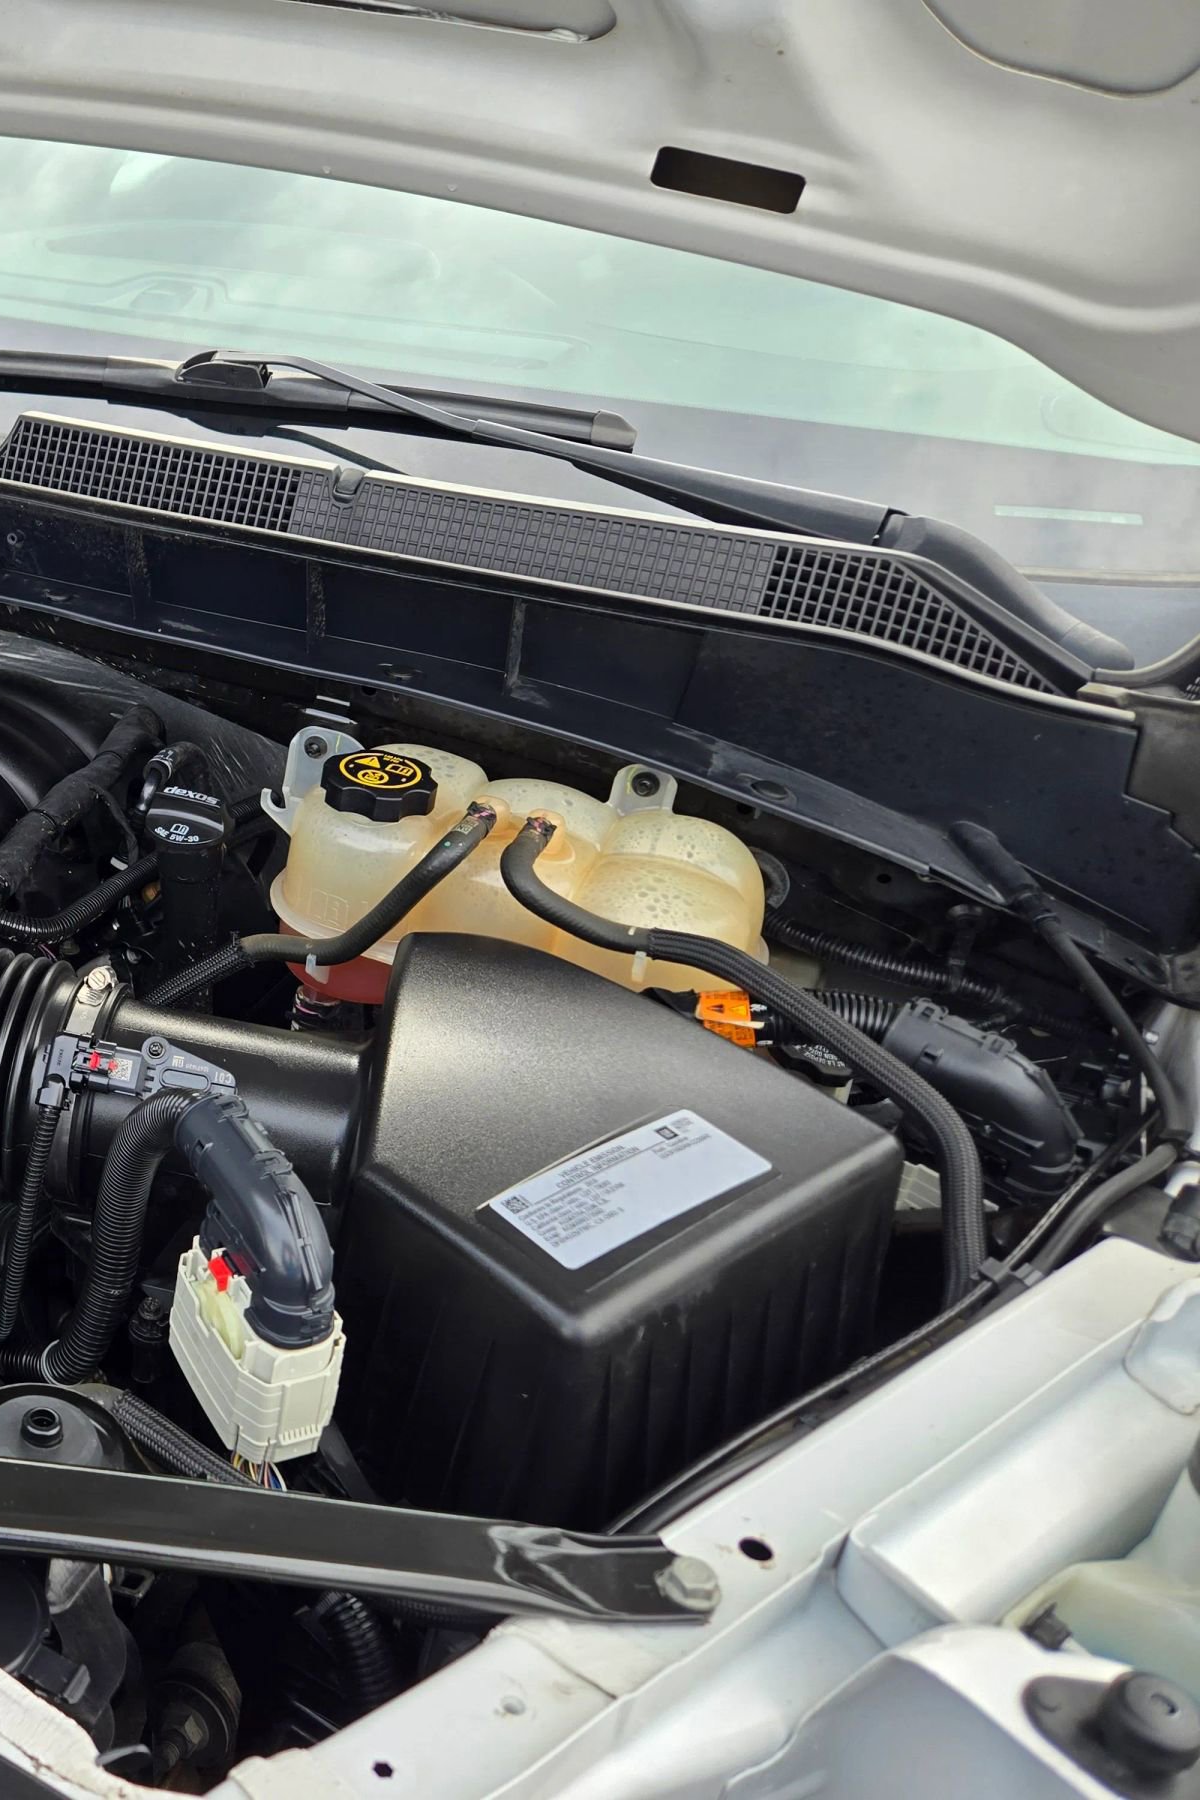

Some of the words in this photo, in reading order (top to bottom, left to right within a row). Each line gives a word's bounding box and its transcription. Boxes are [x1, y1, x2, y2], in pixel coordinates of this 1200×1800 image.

[163, 786, 220, 805] dexos
[154, 826, 169, 838] SAE
[169, 834, 199, 842] 5W-30
[556, 1170, 592, 1188] CONTROL
[591, 1146, 640, 1172] INFORMATION
[559, 1160, 590, 1178] VEHICLE
[590, 1145, 624, 1162] EMISSION
